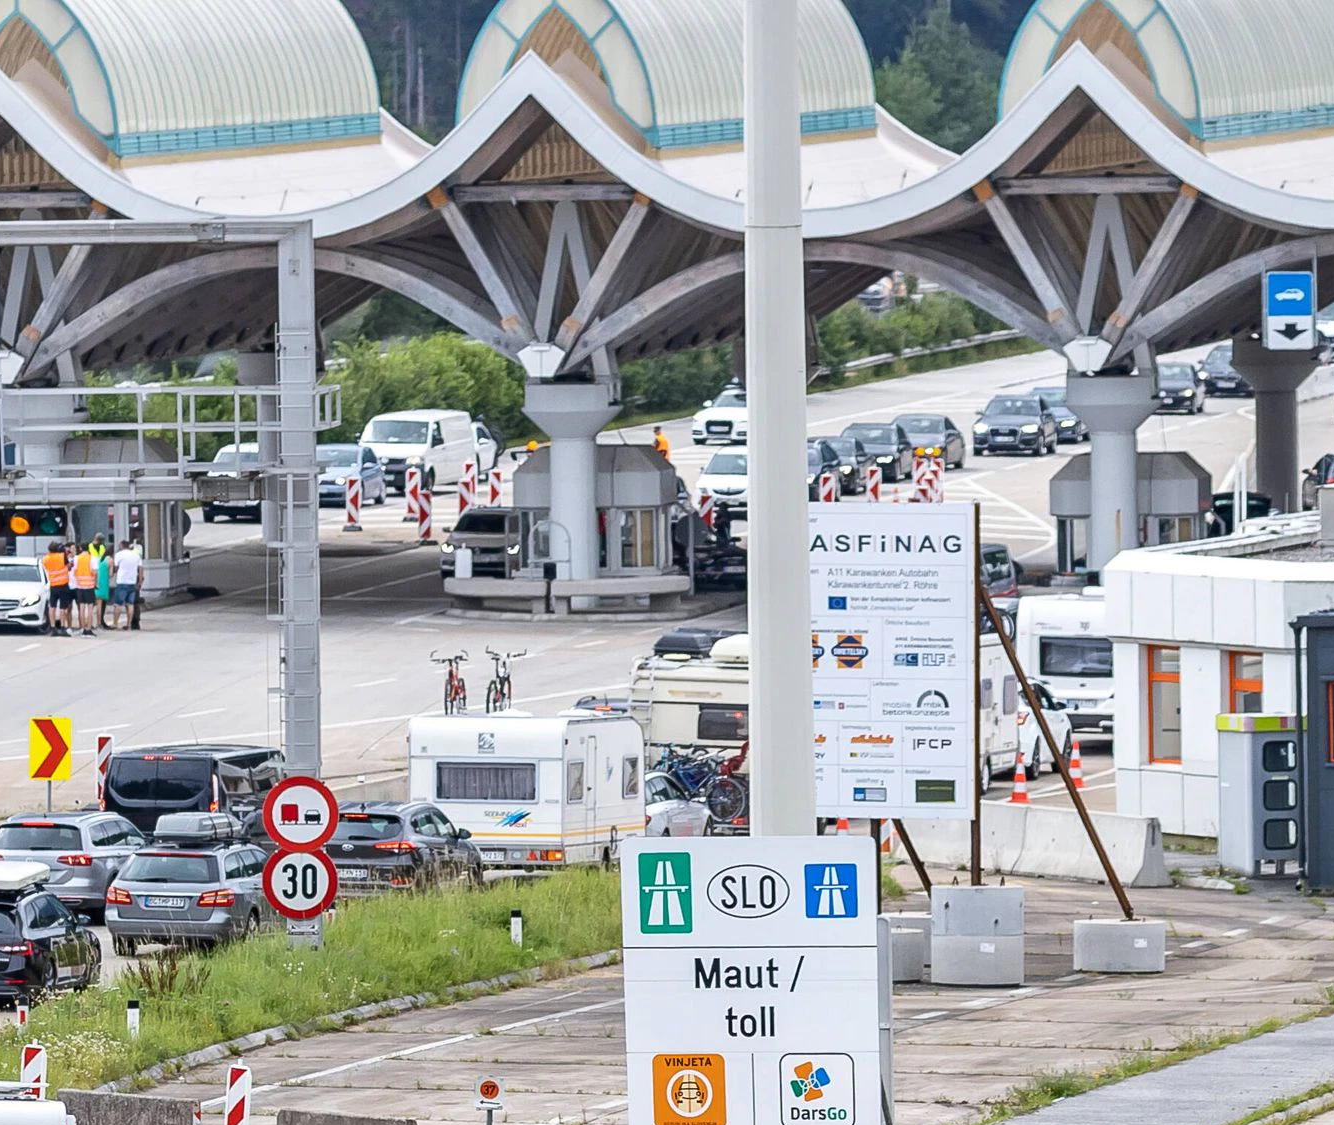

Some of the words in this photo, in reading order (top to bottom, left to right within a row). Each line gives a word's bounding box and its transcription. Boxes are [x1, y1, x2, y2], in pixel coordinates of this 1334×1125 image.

[846, 568, 897, 577] Karawanken
[899, 568, 939, 577] Autobahn
[914, 581, 938, 590] Röhre
[281, 863, 318, 900] 30
[721, 875, 776, 909] SLO
[694, 957, 779, 989] Maut
[725, 1006, 775, 1037] toll
[665, 1057, 712, 1067] VINJETA
[483, 1085, 496, 1096] 37
[790, 1107, 847, 1121] DarsGo
